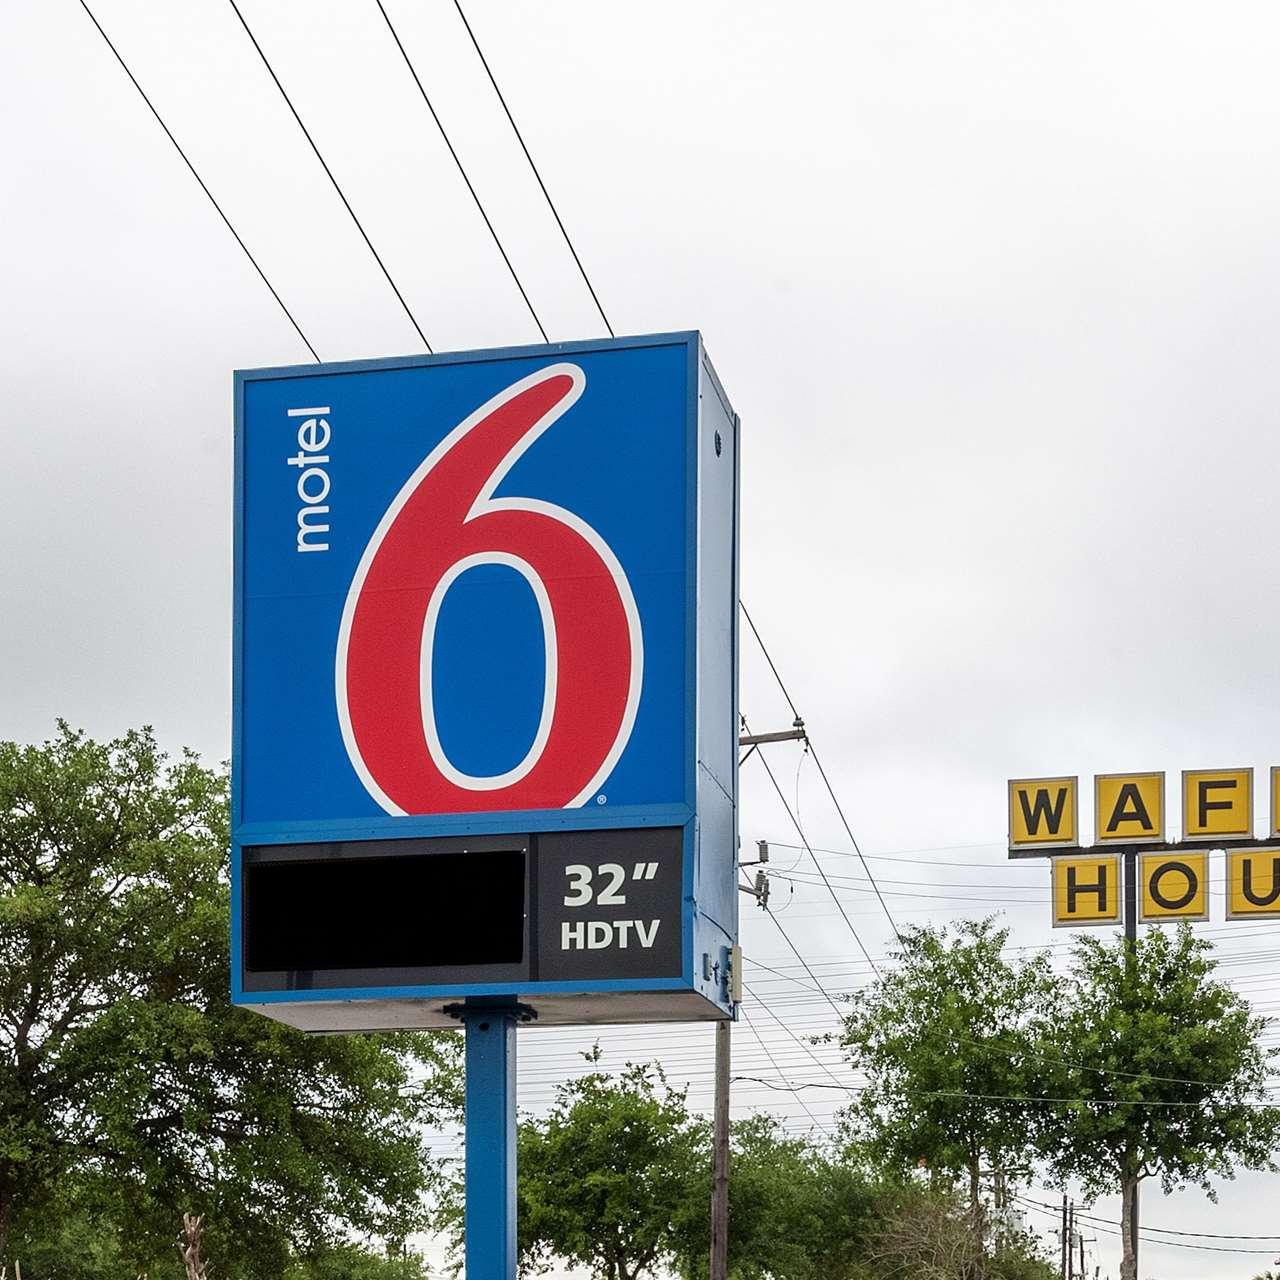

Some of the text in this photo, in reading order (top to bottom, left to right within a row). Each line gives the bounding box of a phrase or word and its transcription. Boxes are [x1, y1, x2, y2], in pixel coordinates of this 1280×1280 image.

[287, 362, 645, 817] motel 6
[561, 919, 661, 950] HDTV
